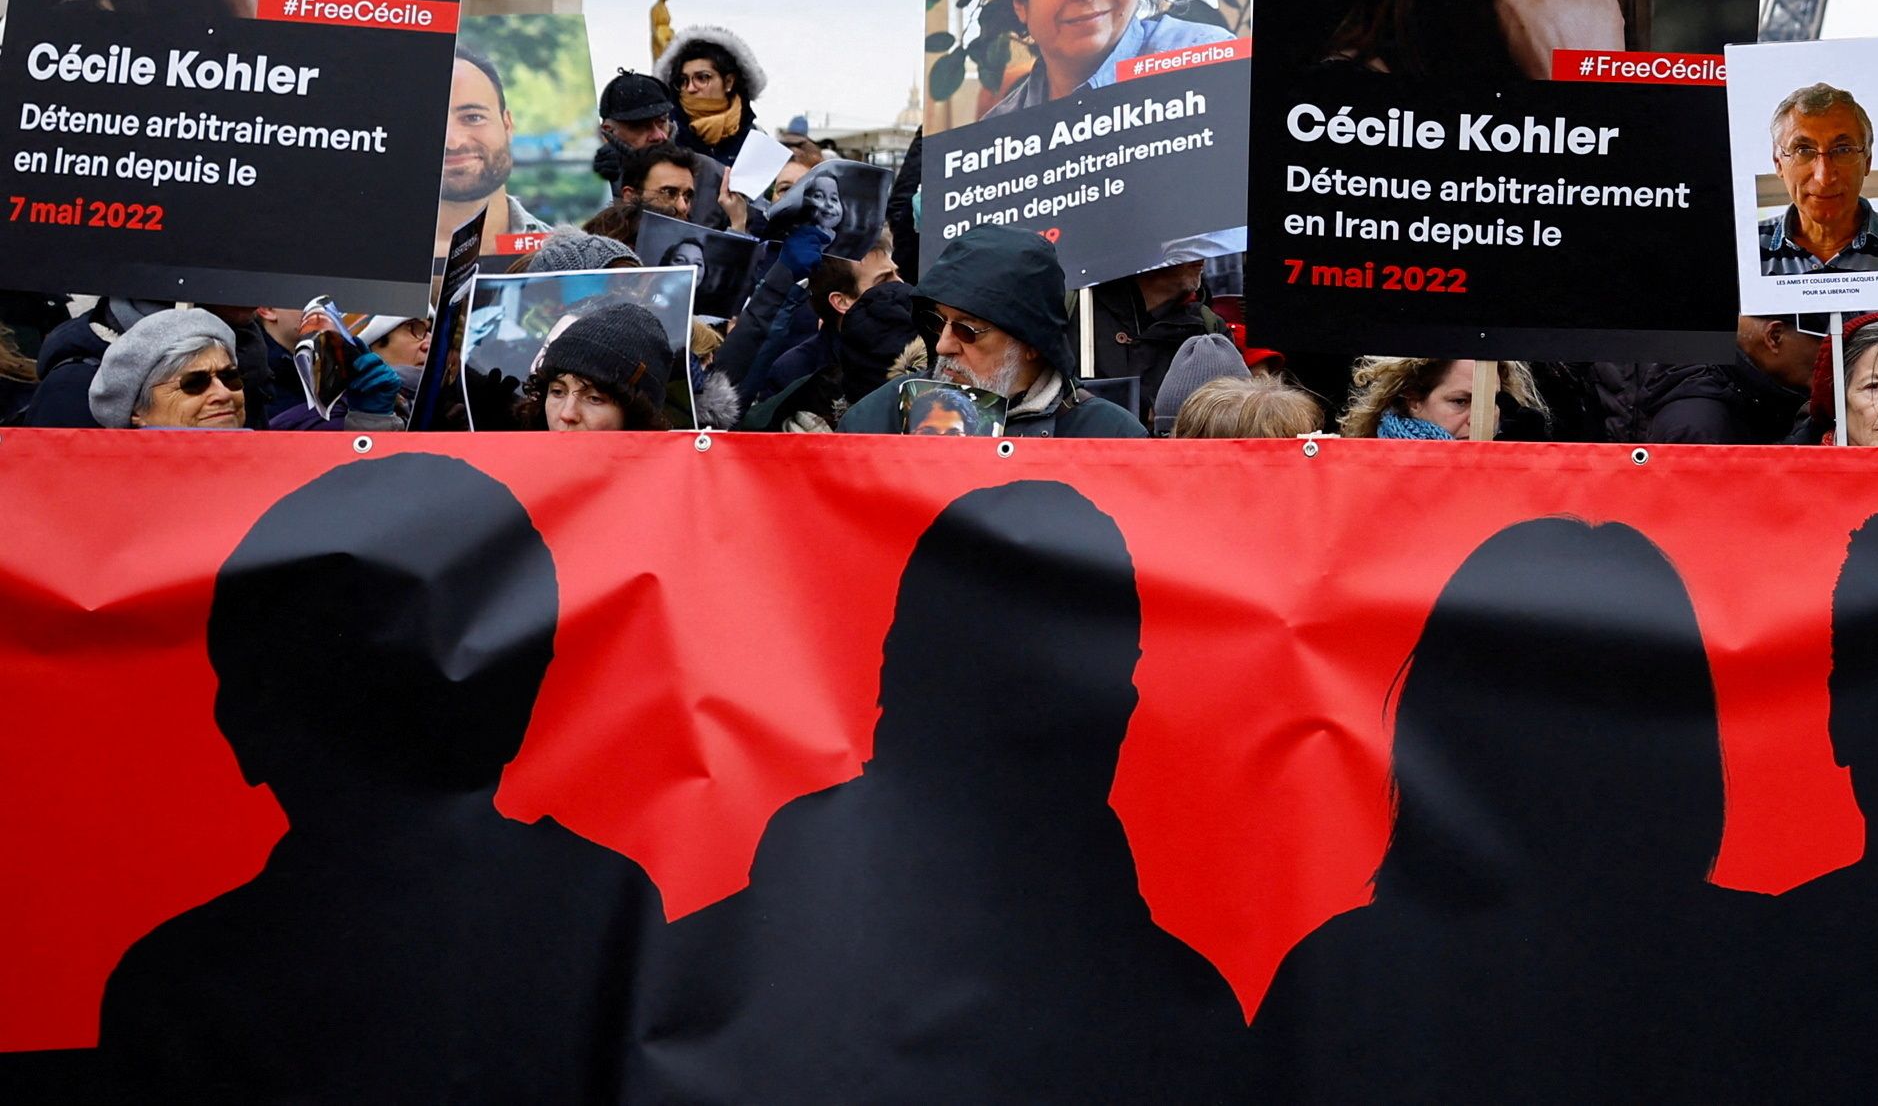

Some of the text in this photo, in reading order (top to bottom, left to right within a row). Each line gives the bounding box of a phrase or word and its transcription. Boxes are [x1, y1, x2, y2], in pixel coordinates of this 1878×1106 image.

[28, 43, 319, 95] Cécile Kohler
[1134, 45, 1234, 74] #FreeFariba
[1579, 56, 1726, 81] #FreeCécile
[21, 104, 387, 152] Détenue arbitrairement
[945, 91, 1205, 178] Fariba Adelkhah
[1287, 104, 1619, 154] Cécile Kohler
[14, 148, 256, 186] en Iran depuis le
[945, 125, 1213, 212] Détenue arbitrairement
[1287, 166, 1690, 208] Détenue arbitrairement
[11, 196, 163, 230] 7 mai 2022
[943, 178, 1124, 239] en Iran depuis le
[1285, 211, 1561, 250] en Iran depuis le
[1285, 260, 1466, 292] 7 mai 2022
